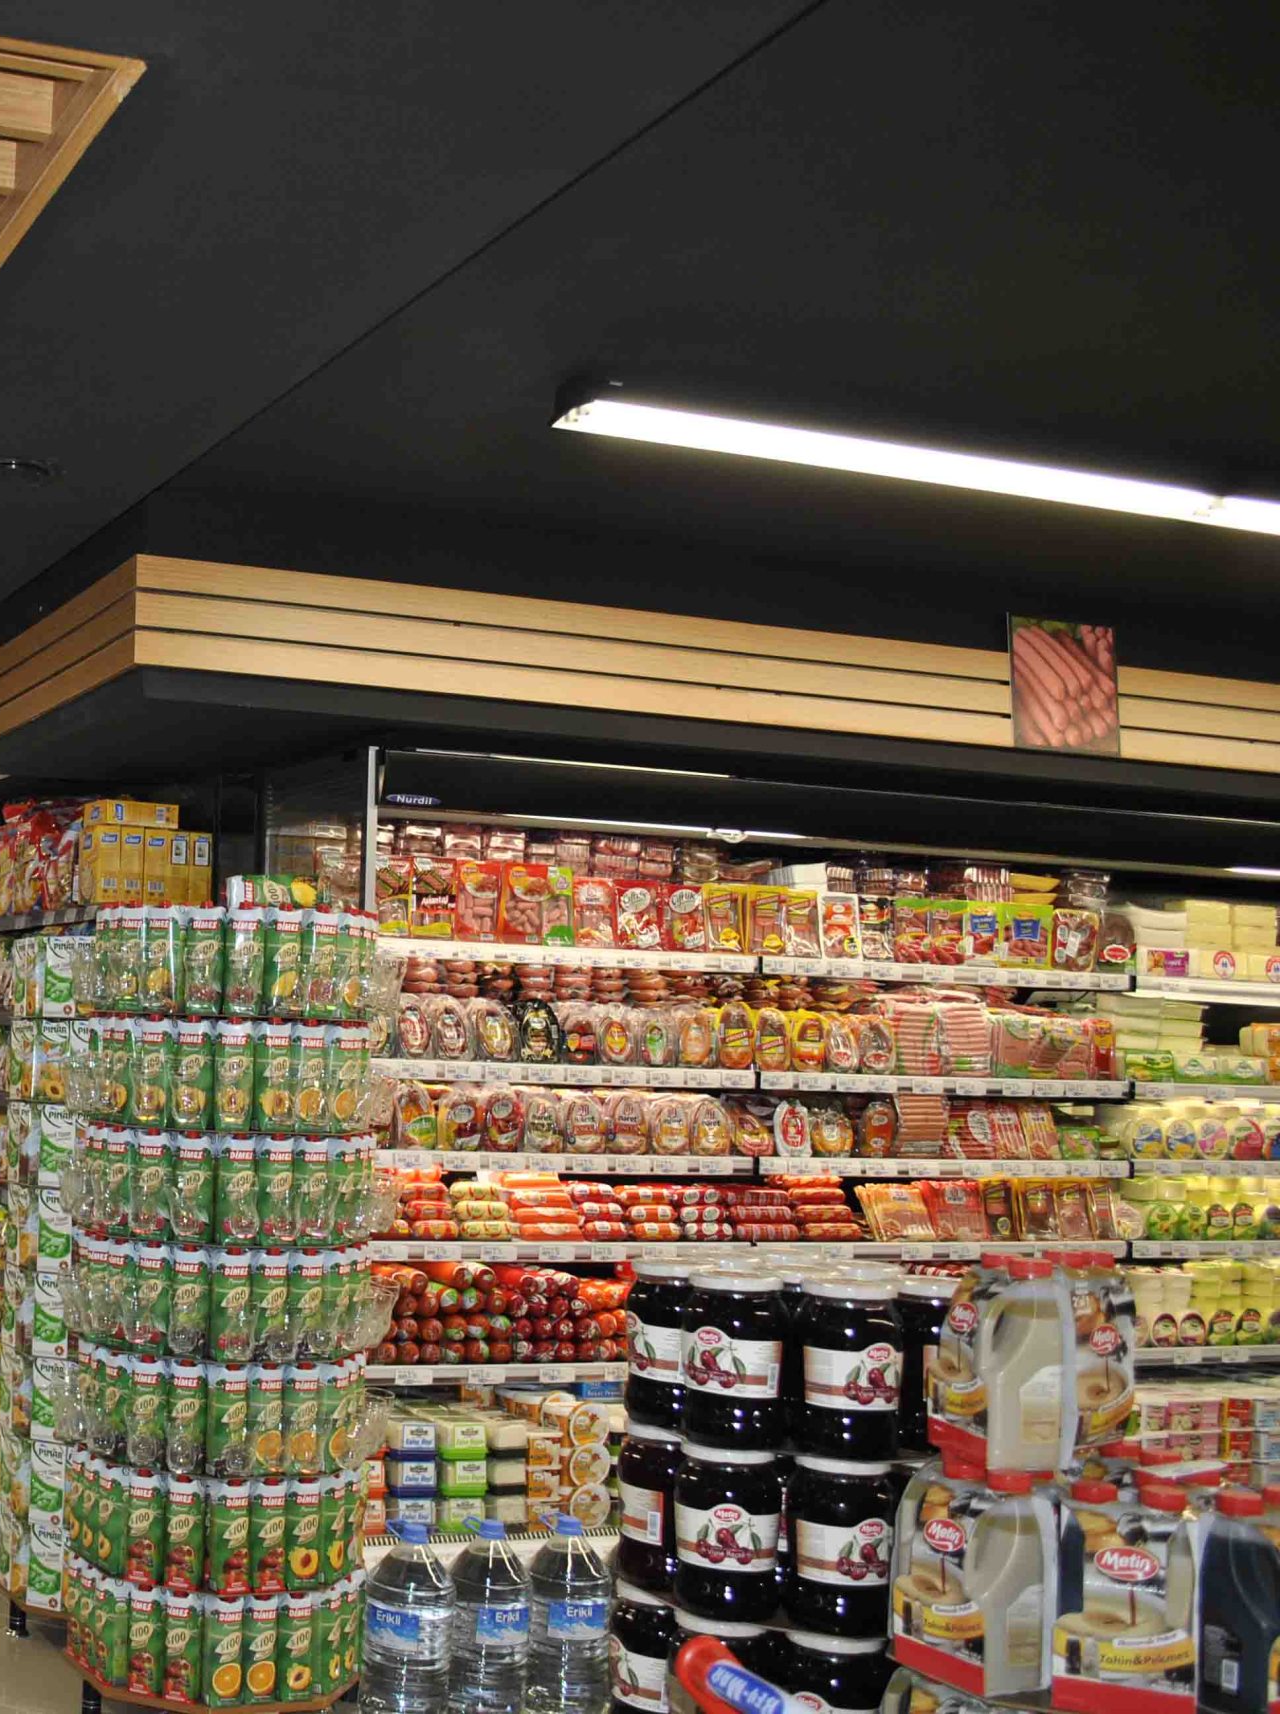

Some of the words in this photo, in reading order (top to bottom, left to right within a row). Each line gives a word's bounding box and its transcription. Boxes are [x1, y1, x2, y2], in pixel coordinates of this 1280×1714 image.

[396, 795, 432, 805] Nurdil
[927, 1522, 961, 1545] Metin
[1100, 1551, 1152, 1571] Metin
[375, 1610, 402, 1625] Erikli
[495, 1610, 520, 1623] Erikli
[566, 1605, 593, 1618] Erikli
